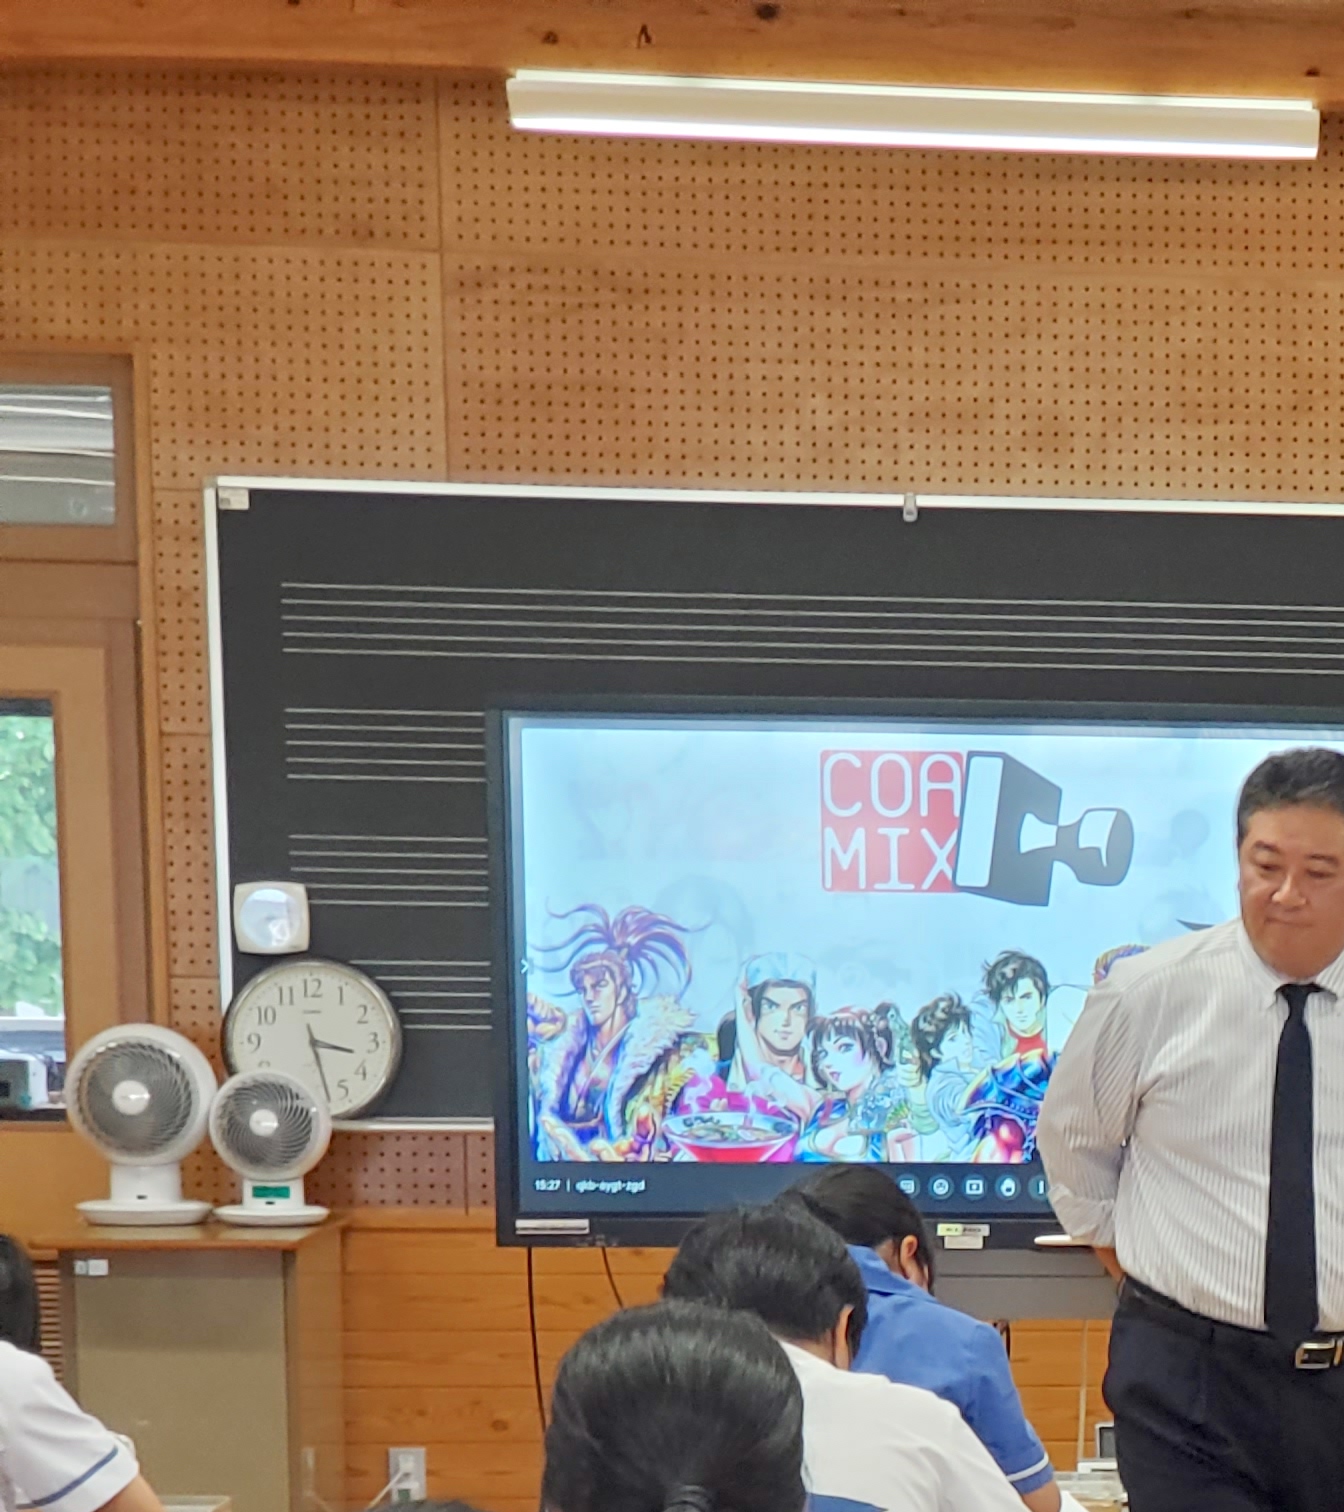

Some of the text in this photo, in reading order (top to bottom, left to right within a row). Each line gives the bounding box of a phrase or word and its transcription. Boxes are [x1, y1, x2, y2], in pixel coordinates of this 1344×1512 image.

[823, 752, 961, 817] COA
[824, 826, 958, 890] MIX
[277, 986, 295, 1005] 11
[303, 979, 322, 998] 12
[338, 986, 345, 1005] 1
[257, 1007, 276, 1025] 10
[357, 1004, 368, 1024] 2
[248, 1033, 261, 1052] 9
[367, 1032, 380, 1053] 3
[355, 1060, 367, 1079] 4
[337, 1080, 349, 1099] 5
